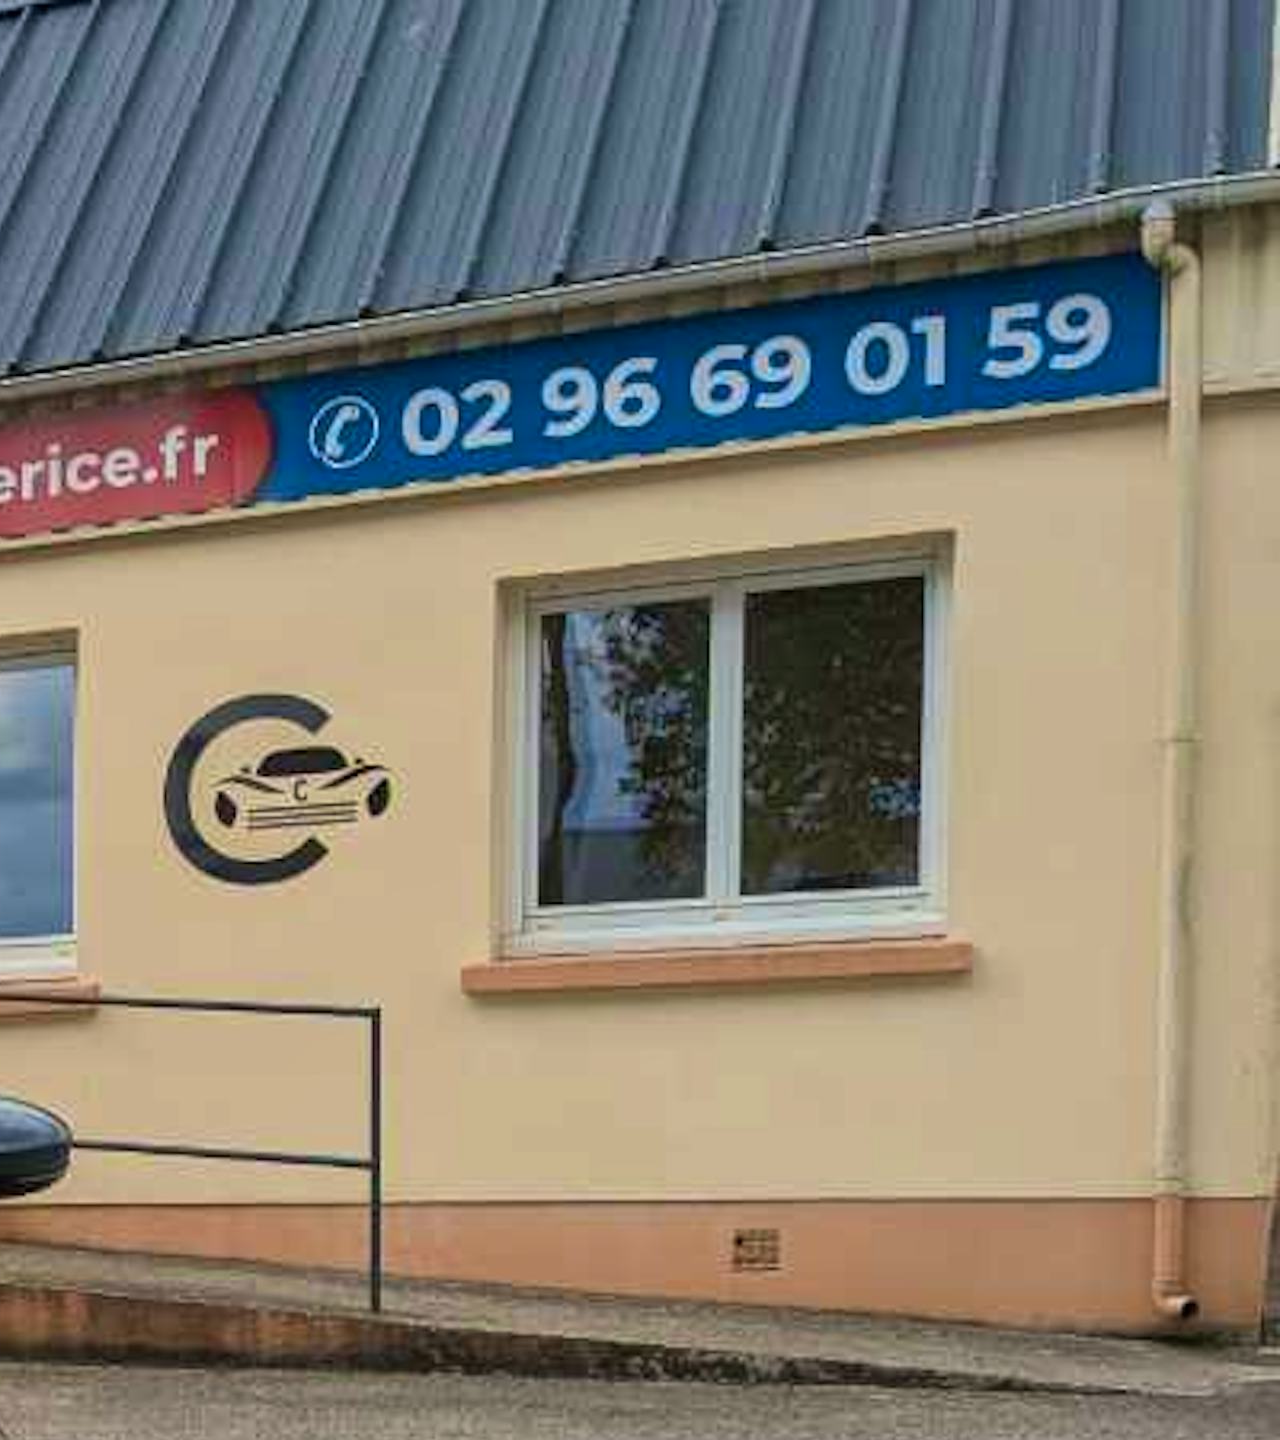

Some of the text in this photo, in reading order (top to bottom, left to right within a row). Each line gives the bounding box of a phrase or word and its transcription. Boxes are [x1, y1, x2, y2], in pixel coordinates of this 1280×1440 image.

[402, 293, 1111, 457] 02 96 69 01 59
